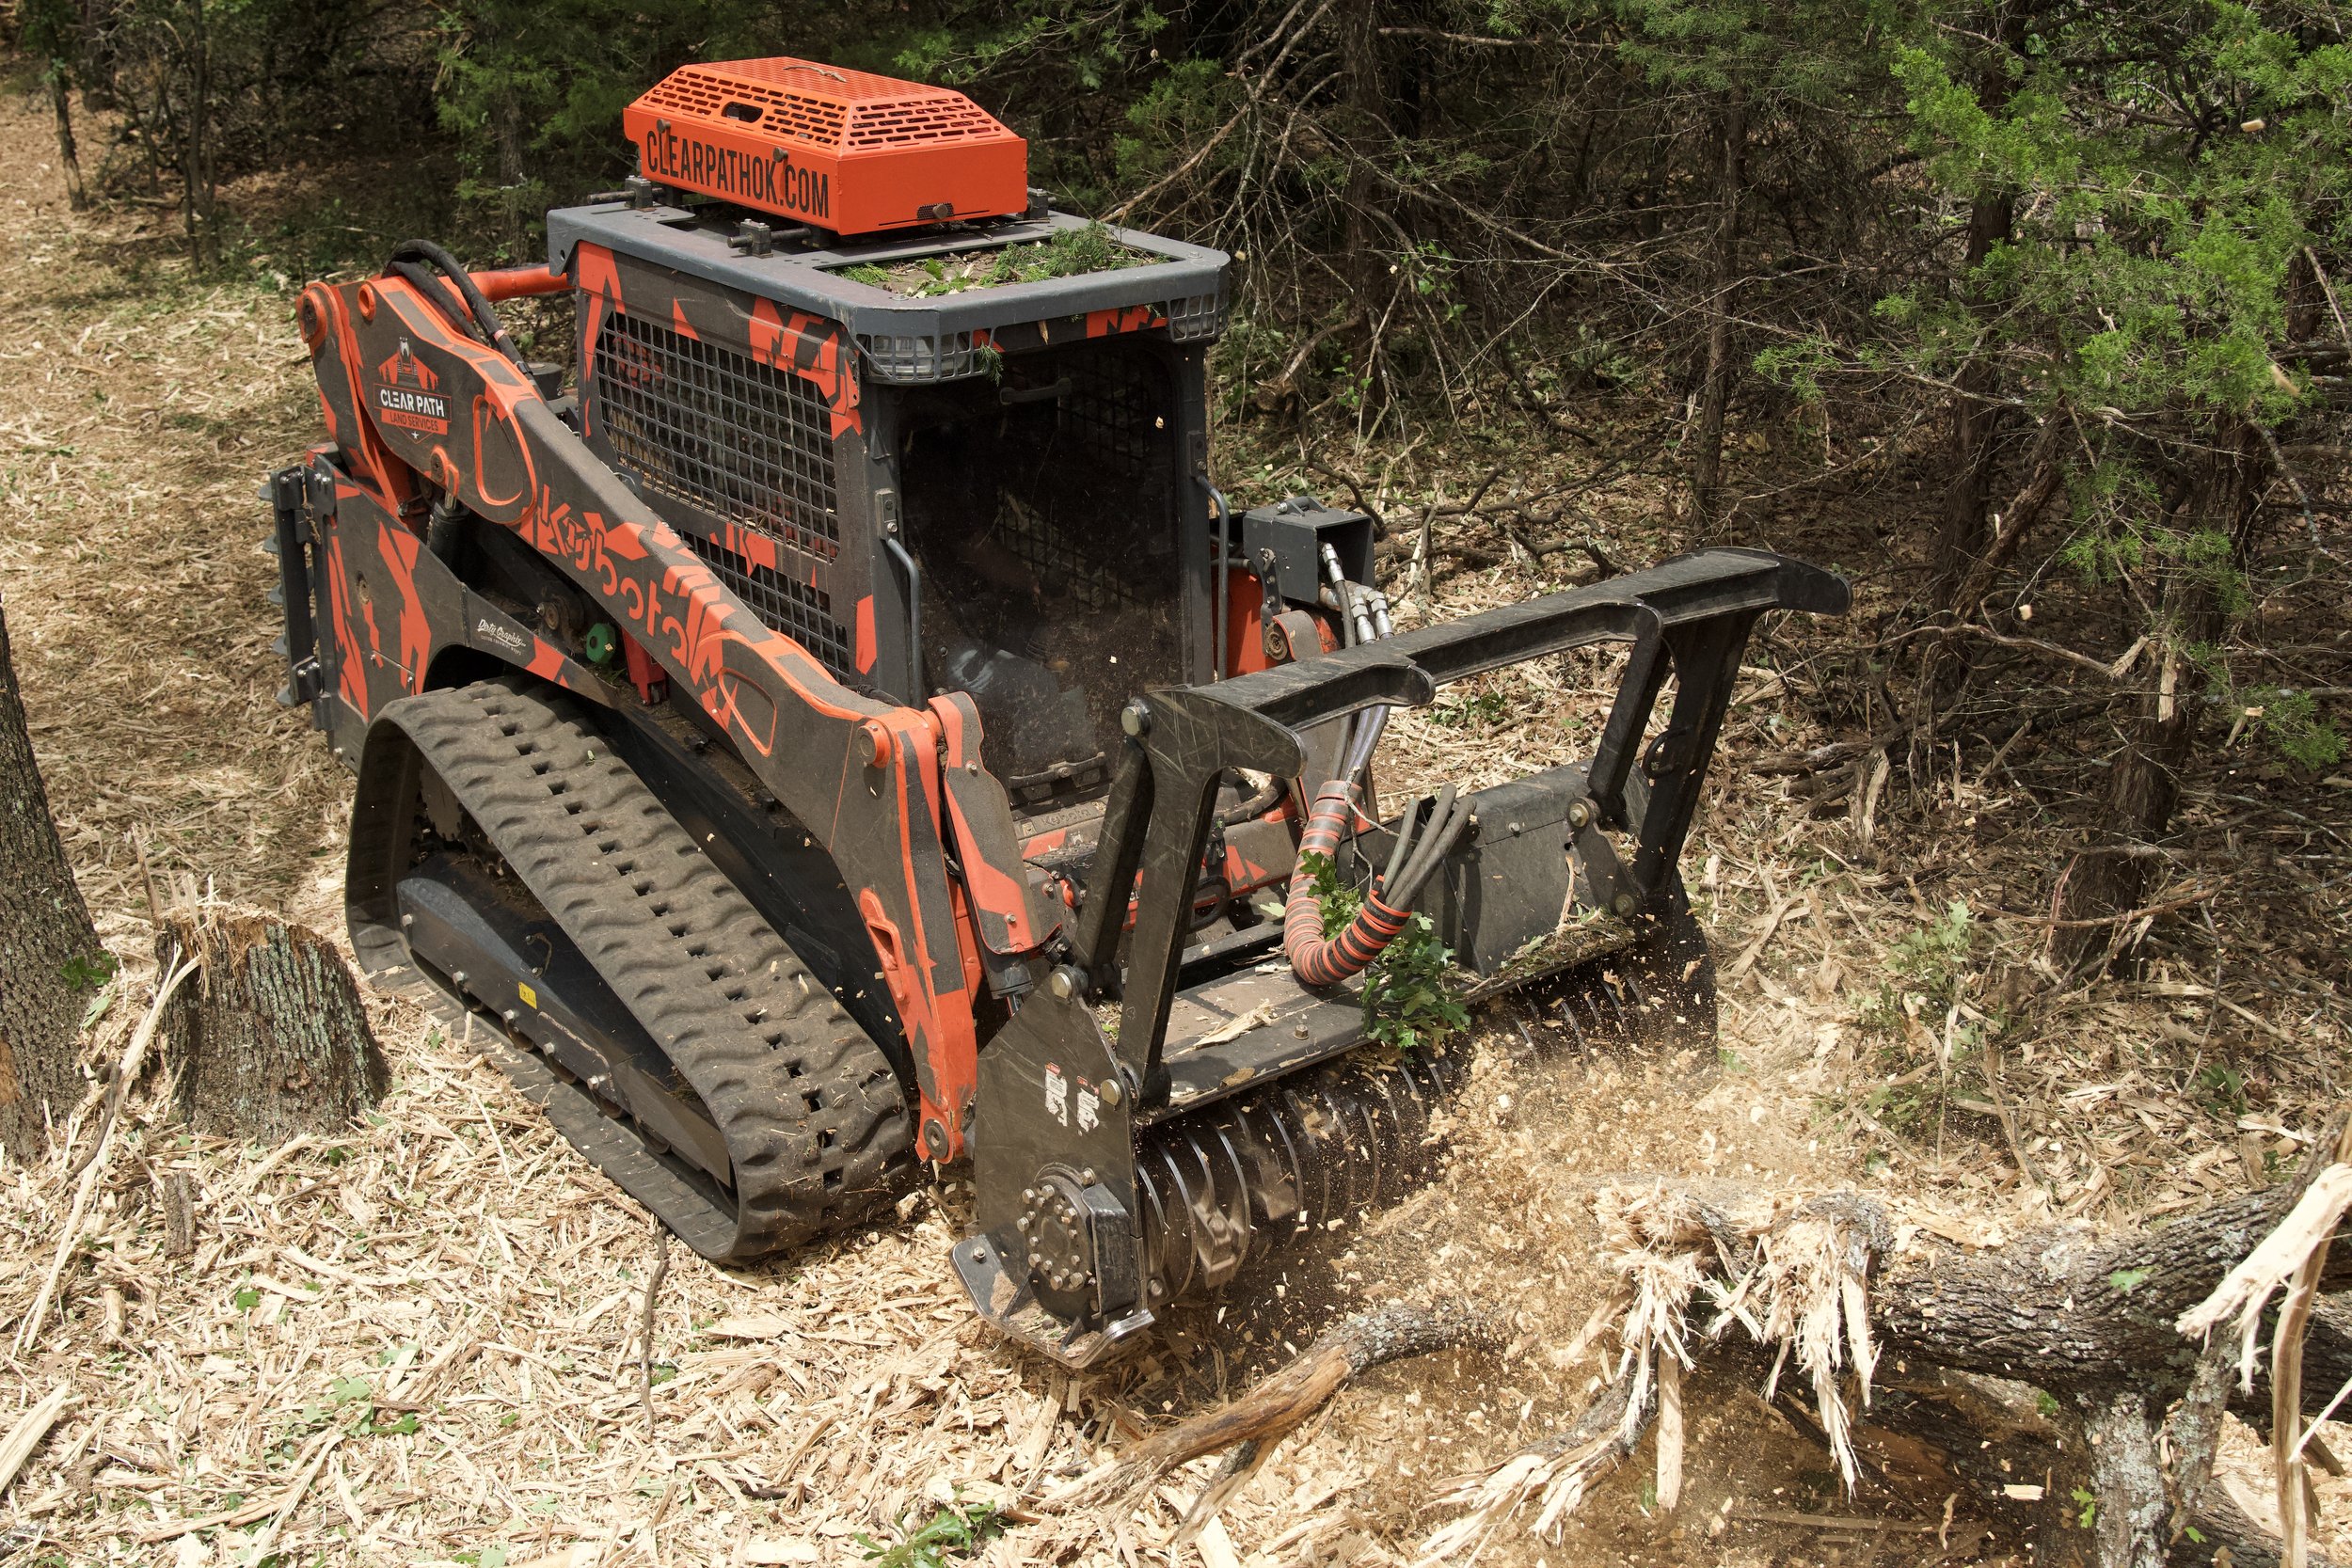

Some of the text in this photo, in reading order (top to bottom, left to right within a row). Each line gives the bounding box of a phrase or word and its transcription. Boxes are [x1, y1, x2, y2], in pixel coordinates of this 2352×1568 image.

[646, 130, 829, 219] CLEARPATHOK.COM
[380, 388, 445, 417] CLEAR PATH
[389, 411, 438, 432] LAND SERVICES
[477, 618, 497, 636] Dirty
